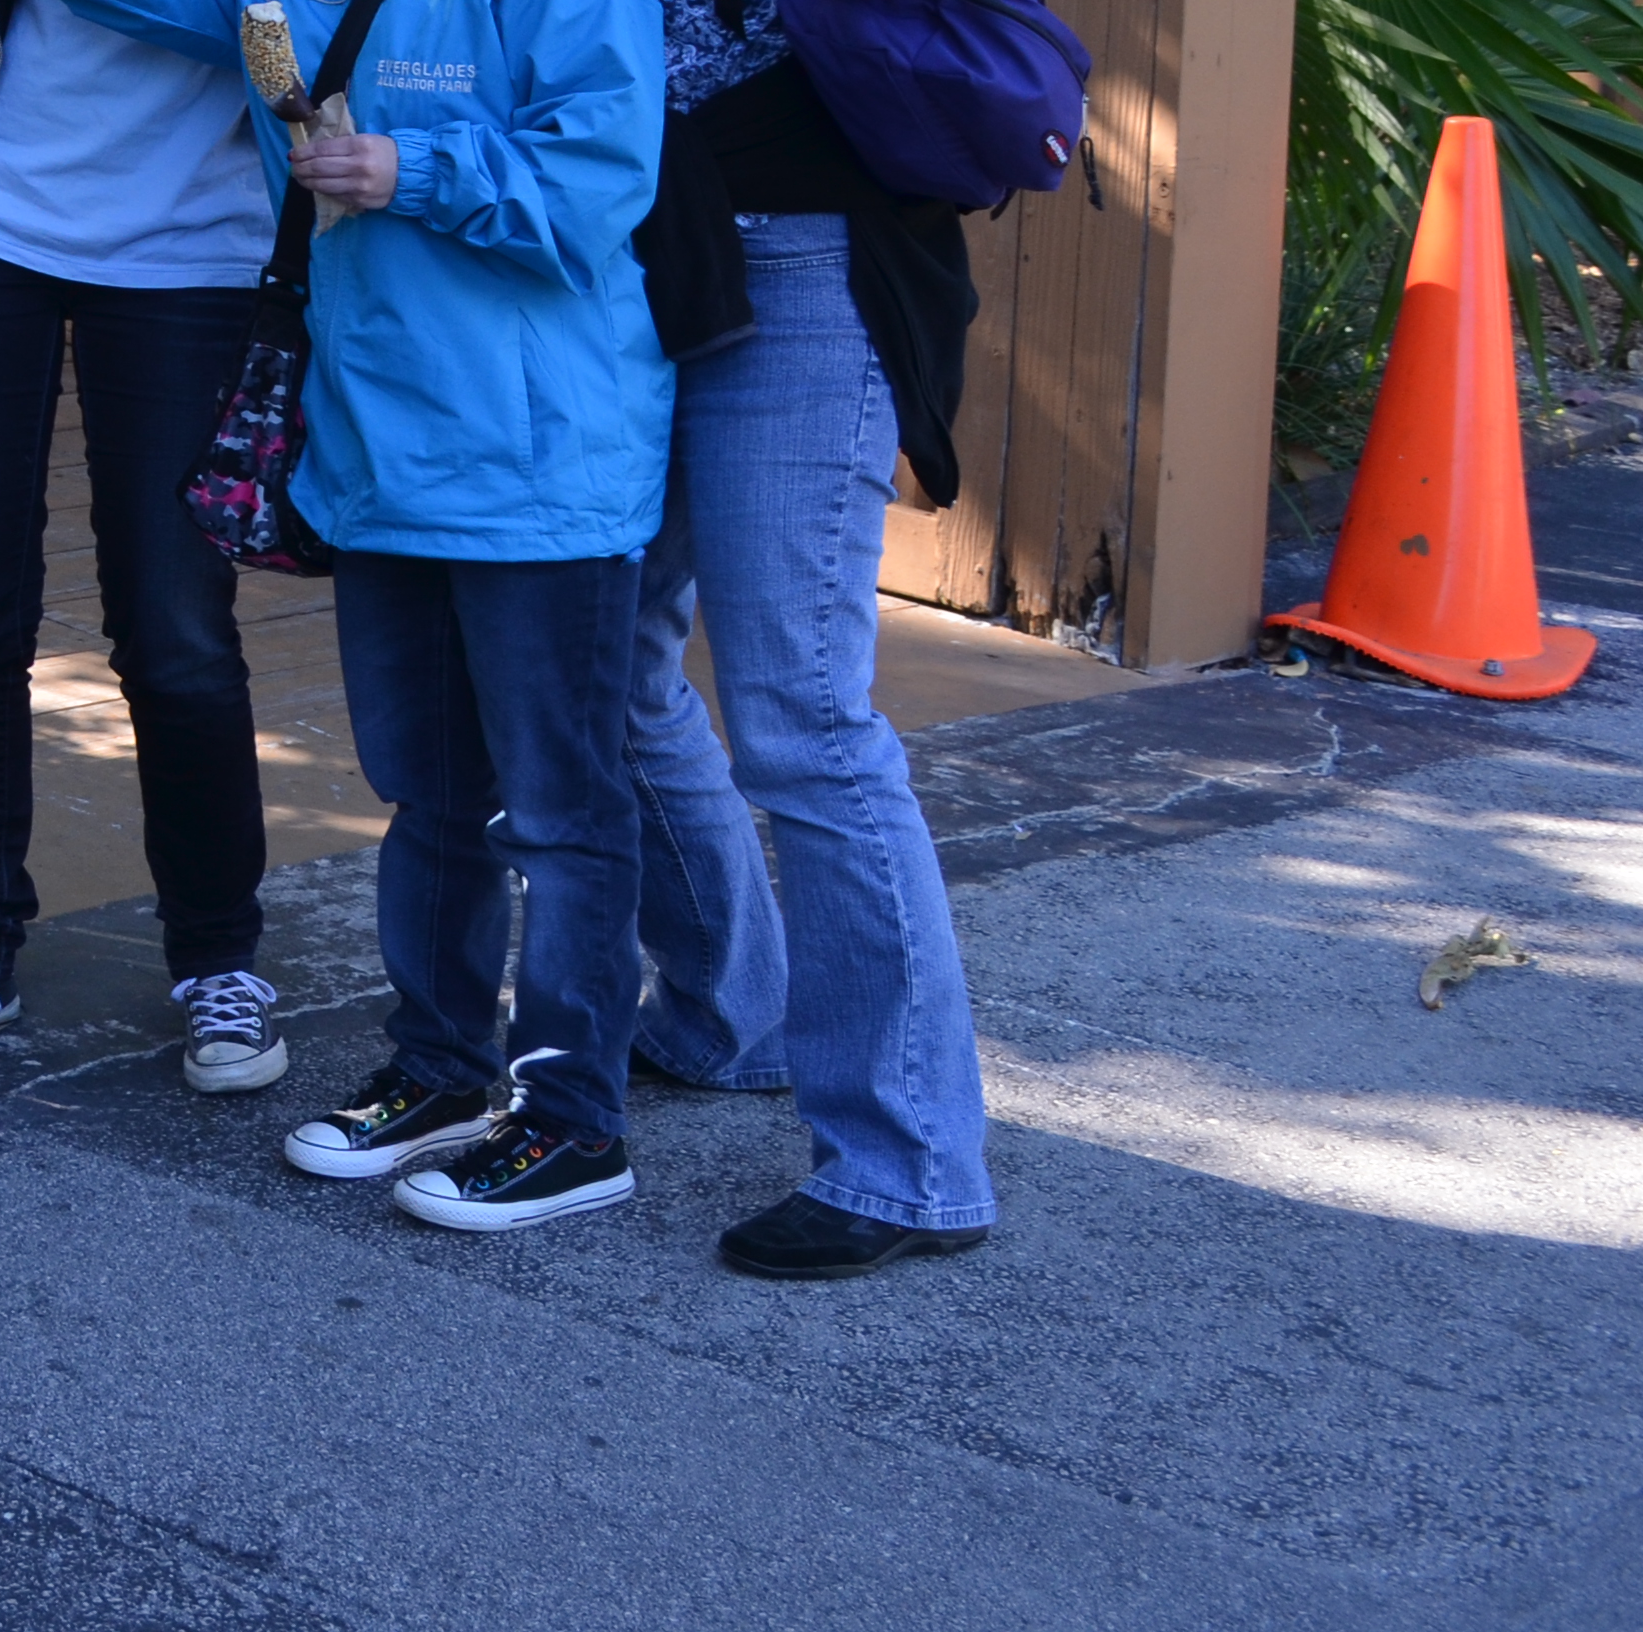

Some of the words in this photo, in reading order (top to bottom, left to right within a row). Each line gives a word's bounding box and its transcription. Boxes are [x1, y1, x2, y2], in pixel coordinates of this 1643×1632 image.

[376, 59, 476, 79] EVERGLADES
[376, 75, 435, 91] ALLIGATOR
[439, 79, 473, 93] FARM
